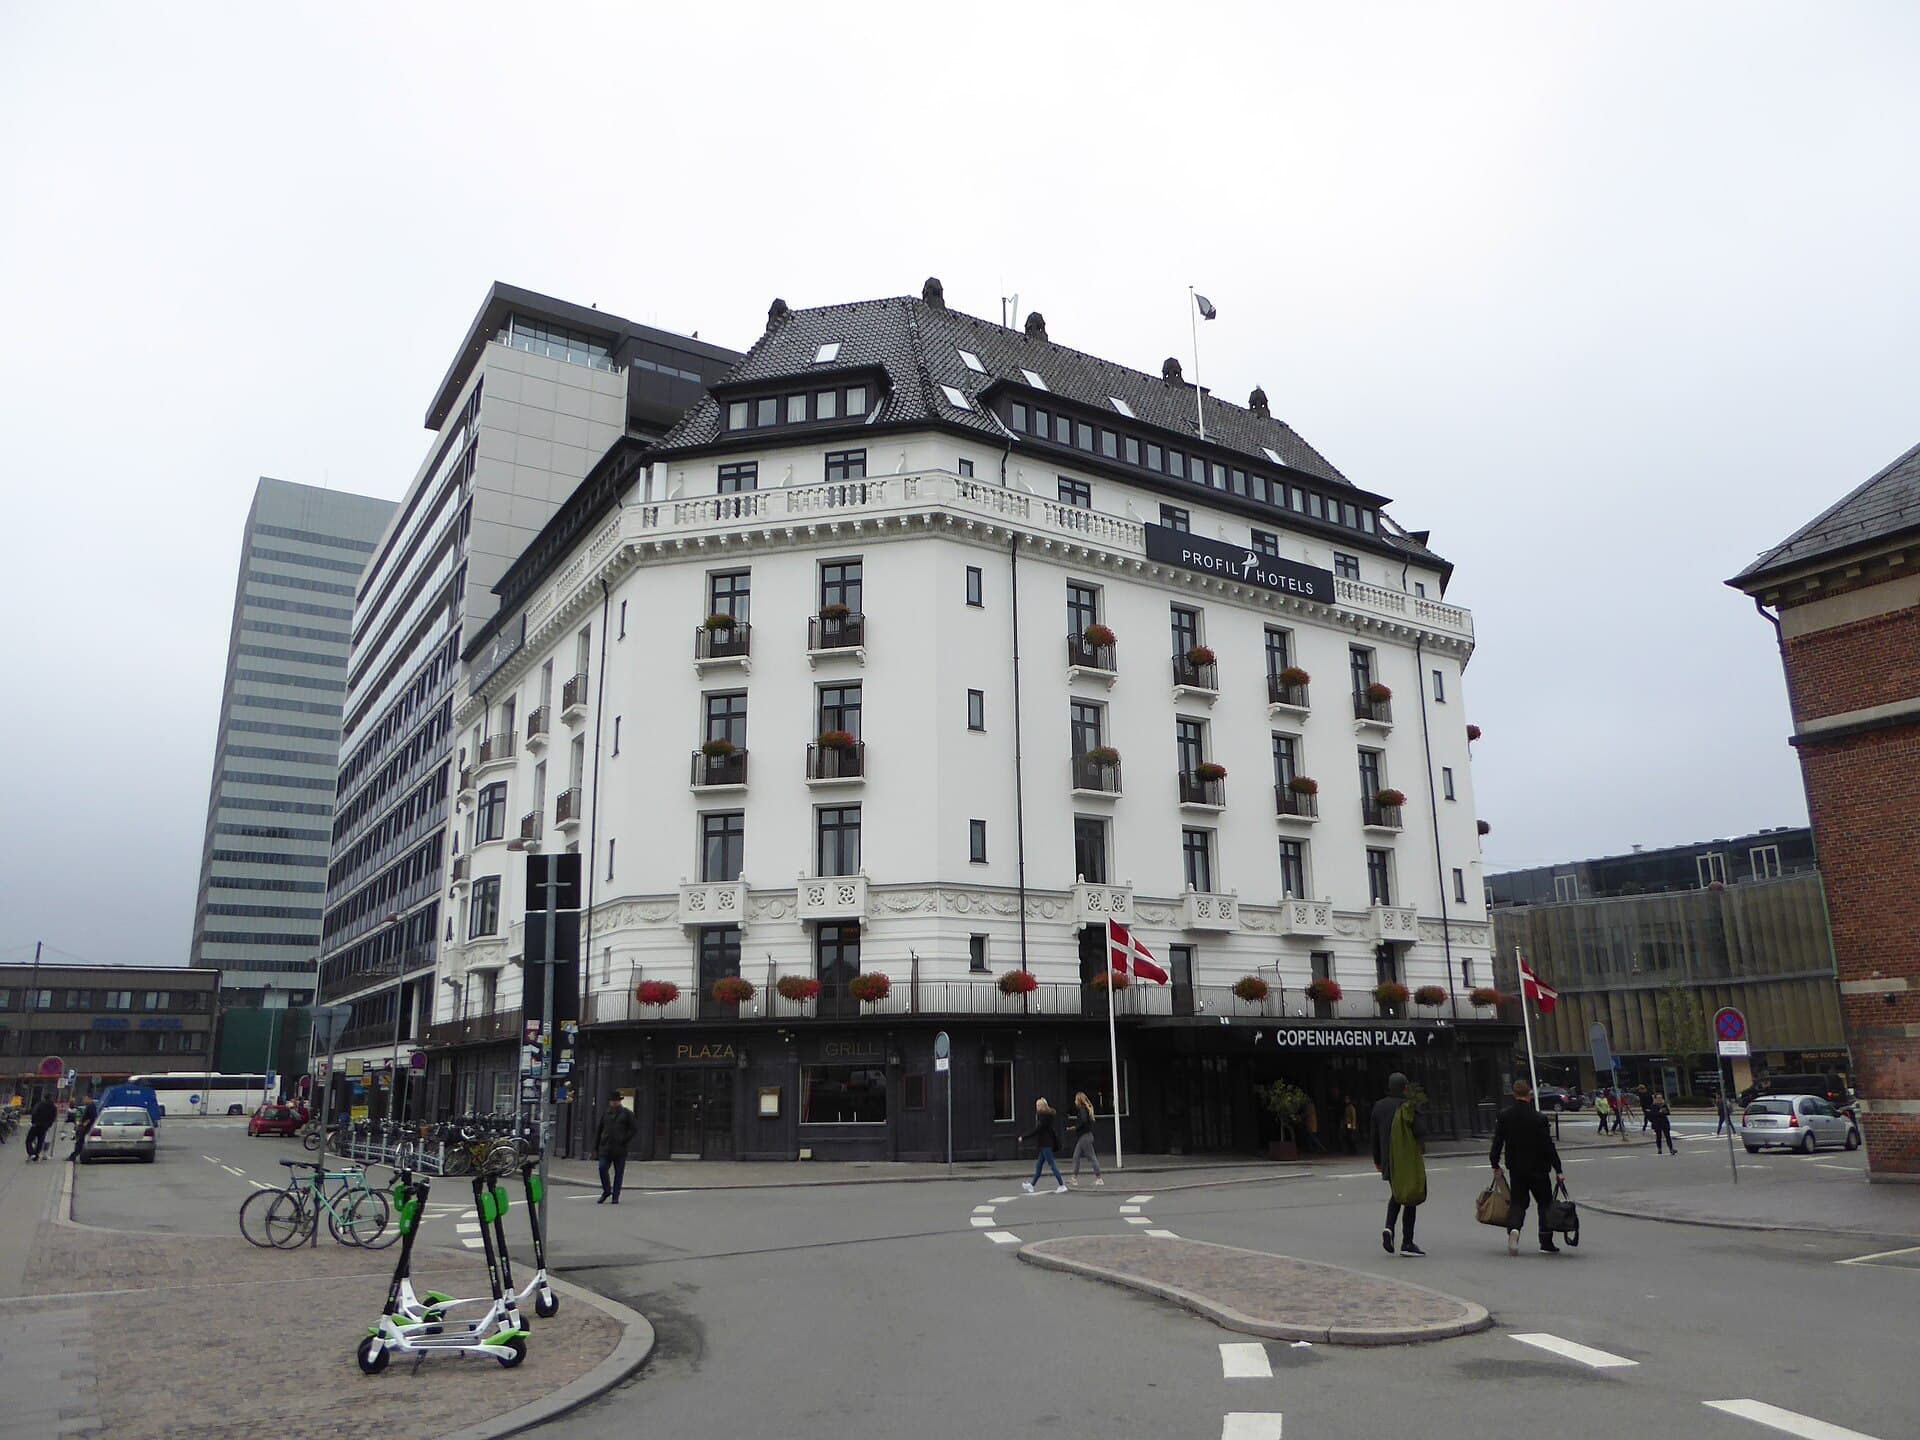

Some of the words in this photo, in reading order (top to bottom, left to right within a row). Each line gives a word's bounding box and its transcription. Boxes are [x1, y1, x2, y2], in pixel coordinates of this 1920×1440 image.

[1182, 550, 1239, 575] PROFIL
[1256, 570, 1314, 595] HOTELS
[1276, 1029, 1372, 1046] COPENHAGEN
[1375, 1030, 1416, 1046] PLAZA
[677, 1045, 735, 1058] PLAZA
[825, 1042, 880, 1056] GRILL
